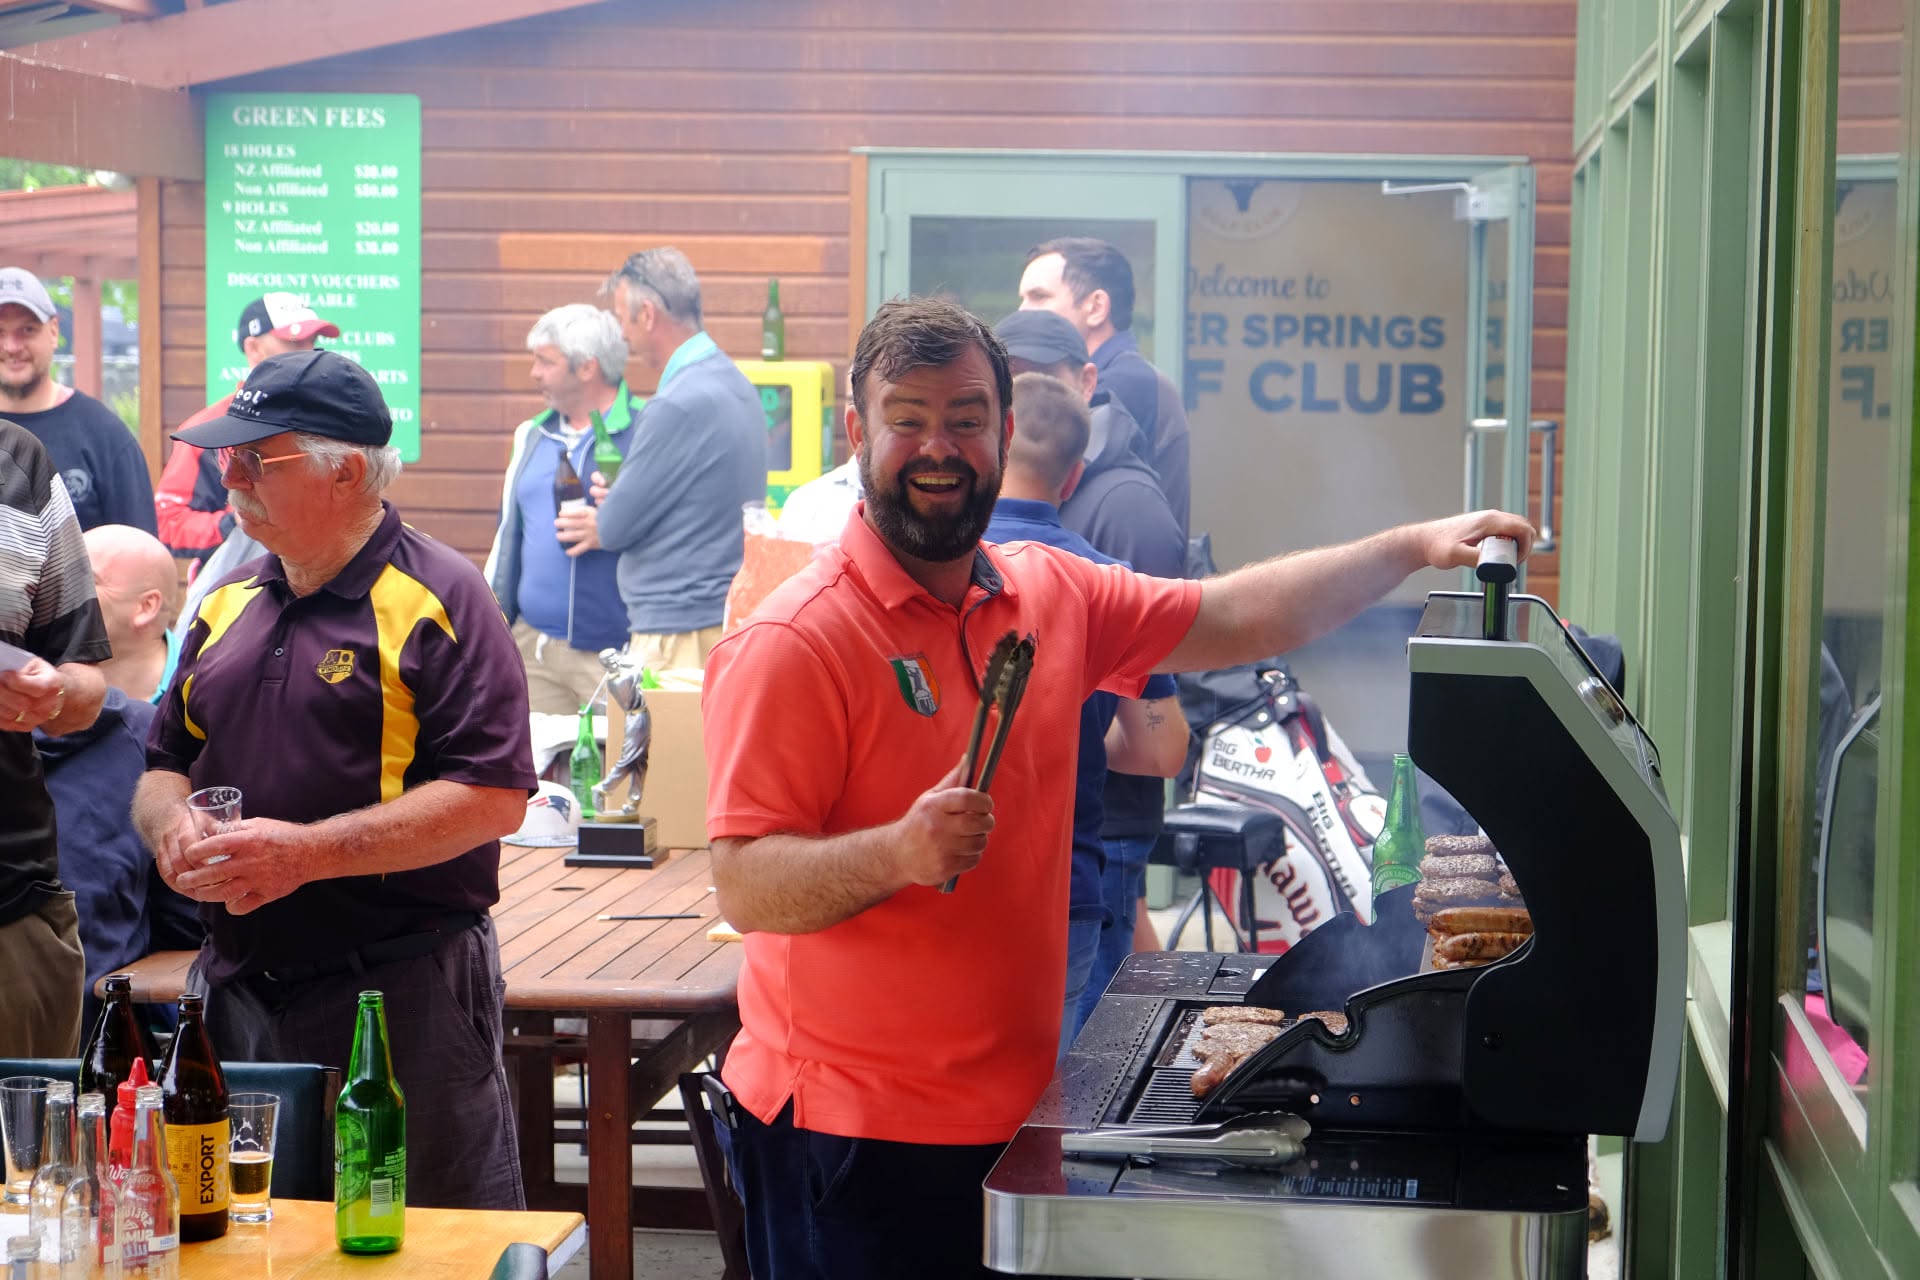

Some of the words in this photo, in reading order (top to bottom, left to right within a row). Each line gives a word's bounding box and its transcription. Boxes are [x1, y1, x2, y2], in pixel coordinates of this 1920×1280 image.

[232, 106, 318, 127] GREEN
[325, 107, 386, 128] FEES
[223, 144, 239, 158] 18
[242, 144, 296, 158] HOLES
[234, 163, 256, 178] NZ
[258, 163, 322, 179] Affiliated
[234, 182, 262, 197] Non
[264, 182, 328, 198] Affiliated
[234, 201, 288, 215] HOLES
[234, 219, 256, 234] NZ
[258, 220, 323, 235] Affiliated
[234, 239, 262, 254] Non
[264, 239, 328, 255] Affiliated
[227, 272, 308, 288] DISCOUNT
[311, 274, 400, 290] VOUCHERS
[1304, 269, 1331, 300] to
[342, 331, 396, 346] CLUBS
[1241, 313, 1446, 350] SPRINGS
[1248, 360, 1446, 415] CLUB
[1212, 738, 1238, 756] BIG
[1212, 756, 1276, 781] BERTHA
[1312, 791, 1334, 830] BIG
[1306, 806, 1358, 899] BERTHA
[200, 1134, 215, 1205] EXPORT
[215, 1142, 227, 1203] GOLD
